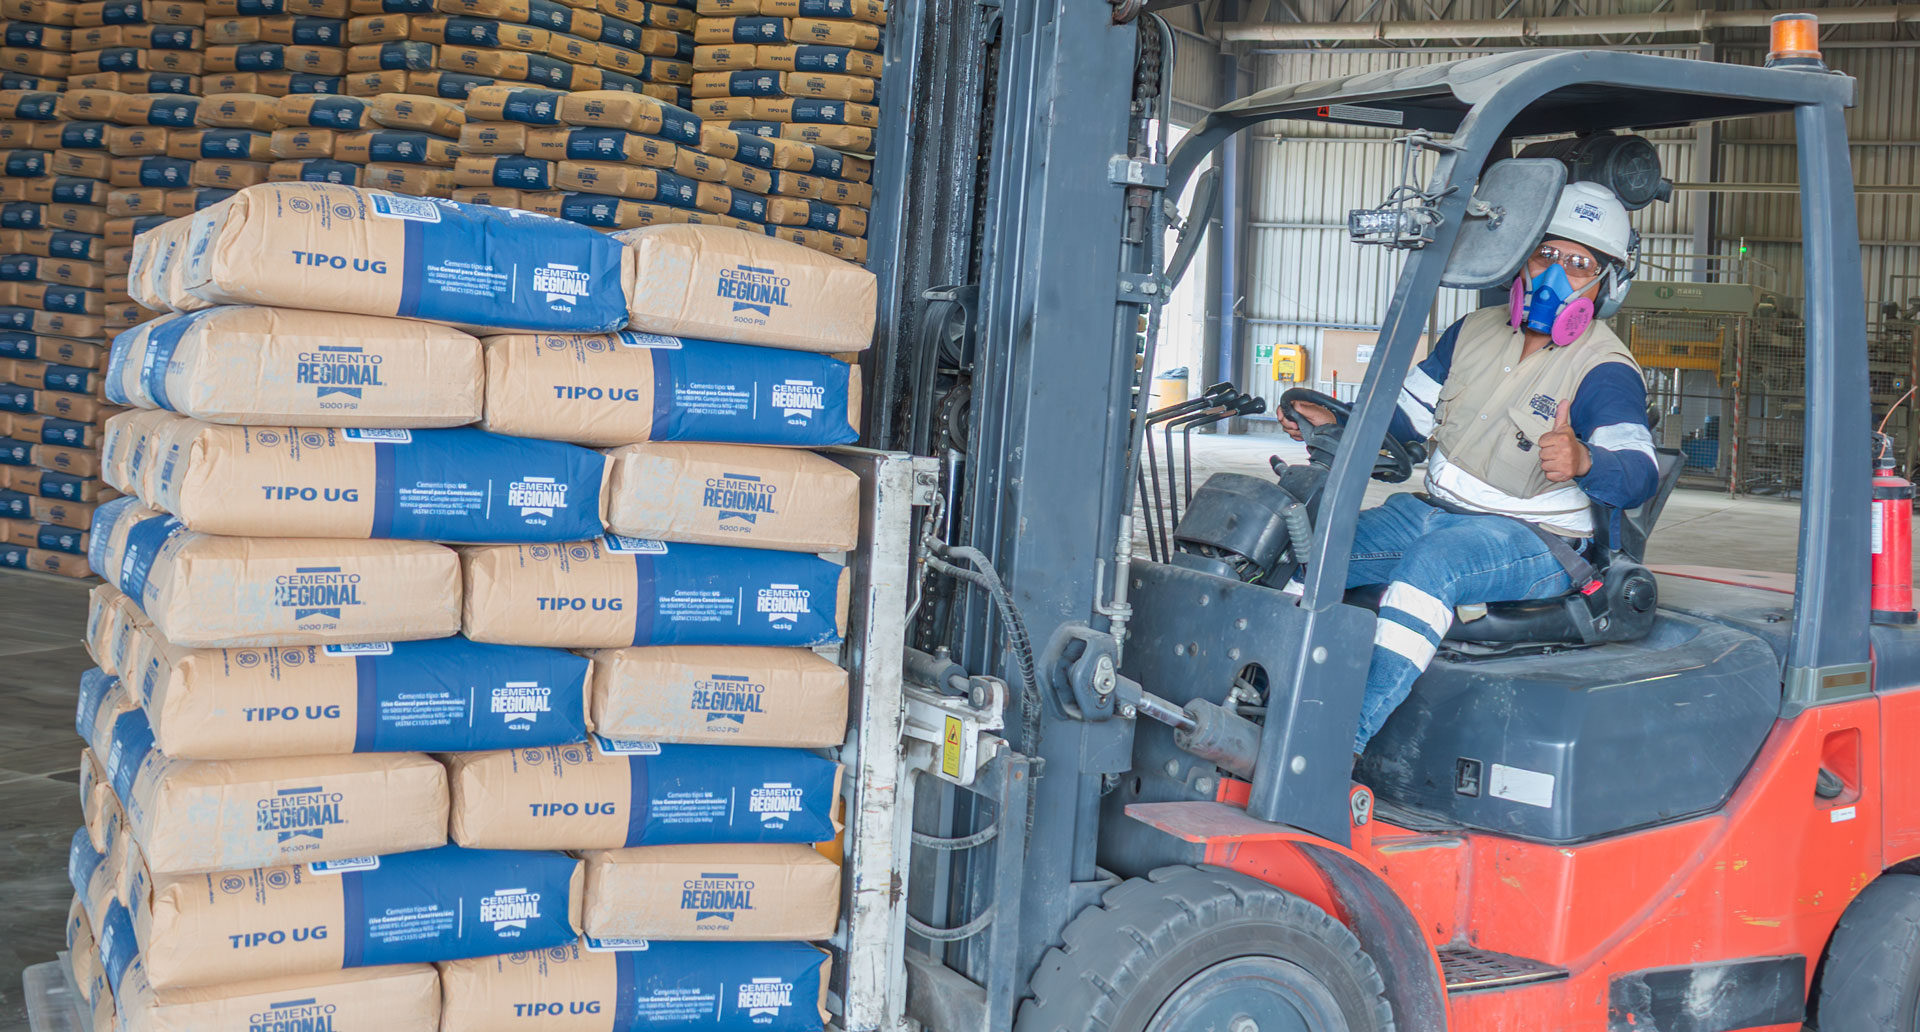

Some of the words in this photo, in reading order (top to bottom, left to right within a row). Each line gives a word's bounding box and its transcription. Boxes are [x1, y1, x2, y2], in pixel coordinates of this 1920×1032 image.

[292, 250, 347, 270] TIPO
[354, 257, 387, 275] UG
[534, 268, 590, 281] CEMENTO
[720, 268, 791, 288] CEMENTO
[533, 275, 589, 296] REGIONAL
[717, 278, 789, 307] REGIONAL
[734, 316, 751, 325] 5000
[751, 318, 766, 326] PSI
[298, 352, 383, 365] CEMENTO
[297, 362, 383, 386] REGIONAL
[554, 385, 604, 400] TIPO
[609, 387, 640, 402] UG
[772, 384, 824, 394] CEMENTO
[772, 392, 824, 409] REGIONAL
[262, 486, 318, 502] TIPO
[324, 488, 359, 502] UG
[510, 482, 568, 492] CEMENTO
[706, 478, 776, 494] CEMENTO
[508, 490, 568, 508] REGIONAL
[704, 488, 775, 514] REGIONAL
[719, 524, 738, 532] 5000
[276, 574, 360, 586] CEMENTO
[275, 582, 360, 606] REGIONAL
[758, 589, 810, 598] CEMENTO
[537, 597, 588, 610] TIPO
[592, 598, 622, 611] UG
[757, 596, 810, 612] REGIONAL
[492, 688, 551, 696] CEMENTO
[694, 680, 766, 694] CEMENTO
[491, 696, 551, 712] REGIONAL
[691, 690, 764, 714] REGIONAL
[243, 706, 299, 722] TIPO
[305, 705, 340, 720] UG
[751, 788, 804, 796] CEMENTO
[257, 793, 344, 809] CEMENTO
[530, 802, 580, 816] TIPO
[585, 802, 616, 816] UG
[750, 796, 802, 812] REGIONAL
[257, 803, 344, 832] REGIONAL
[305, 844, 320, 852] PSI
[684, 880, 756, 890] CEMENTO
[480, 893, 541, 906] CEMENTO
[680, 889, 754, 910] REGIONAL
[480, 902, 541, 922] REGIONAL
[229, 930, 286, 949] TIPO
[293, 925, 328, 942] UG
[740, 983, 794, 992] CEMENTO
[738, 992, 792, 1008] REGIONAL
[249, 1004, 336, 1024] CEMENTO
[513, 1002, 566, 1018] TIPO
[570, 1001, 601, 1014] UG
